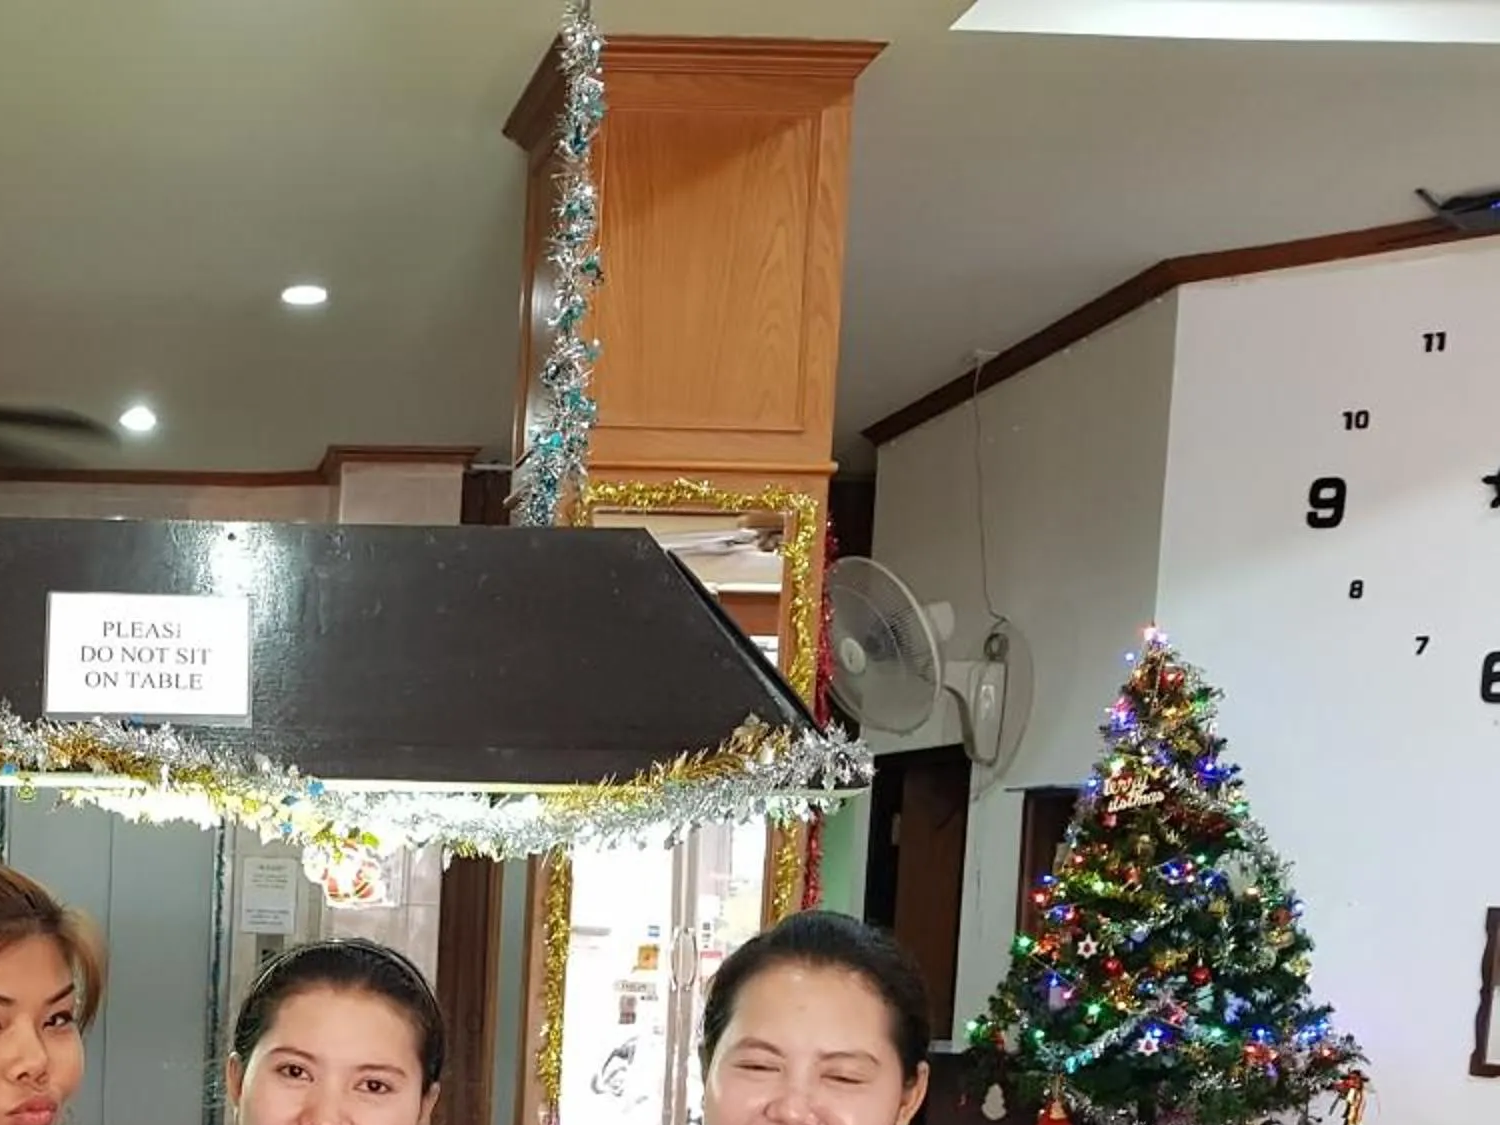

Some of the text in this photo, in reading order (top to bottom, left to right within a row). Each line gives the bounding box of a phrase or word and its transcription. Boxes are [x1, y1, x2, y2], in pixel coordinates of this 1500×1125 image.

[1422, 331, 1447, 353] 11
[1342, 409, 1370, 431] 10
[1306, 477, 1347, 529] 9
[1349, 579, 1364, 599] 8
[80, 645, 212, 665] DO NOT SIT
[1414, 636, 1430, 655] 7
[84, 670, 203, 690] ON TABLE
